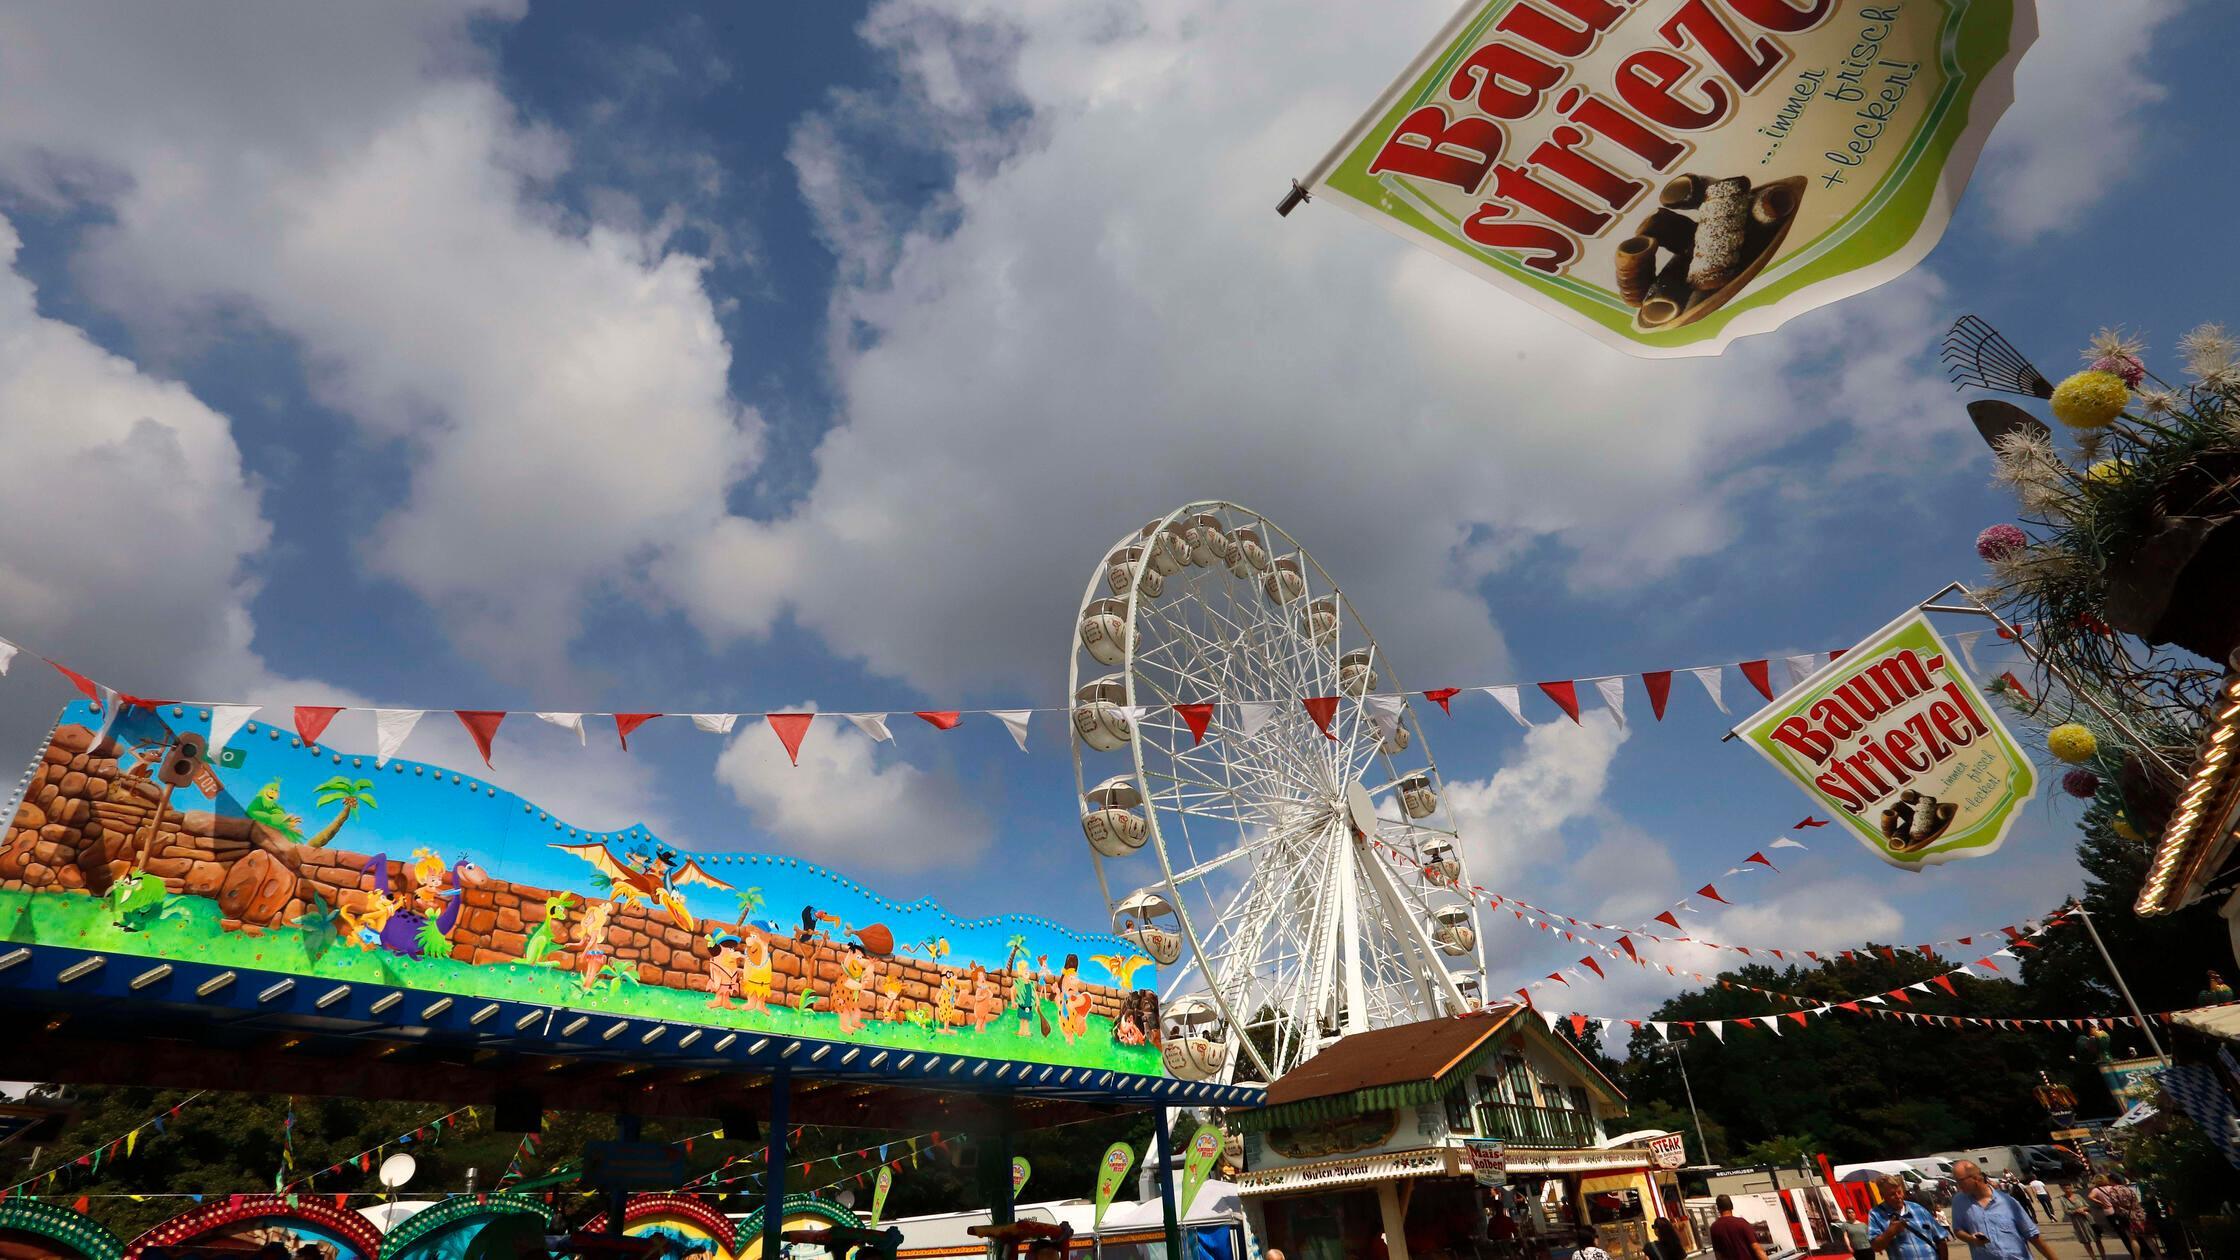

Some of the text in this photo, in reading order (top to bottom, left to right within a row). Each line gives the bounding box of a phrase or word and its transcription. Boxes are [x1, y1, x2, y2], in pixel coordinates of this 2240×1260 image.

[1823, 5, 1901, 103] frisch
[1769, 650, 1946, 767] Baum-
[1814, 681, 1993, 816] striezel
[1302, 1169, 1333, 1181] Guten
[1651, 1136, 1681, 1154] STEAK
